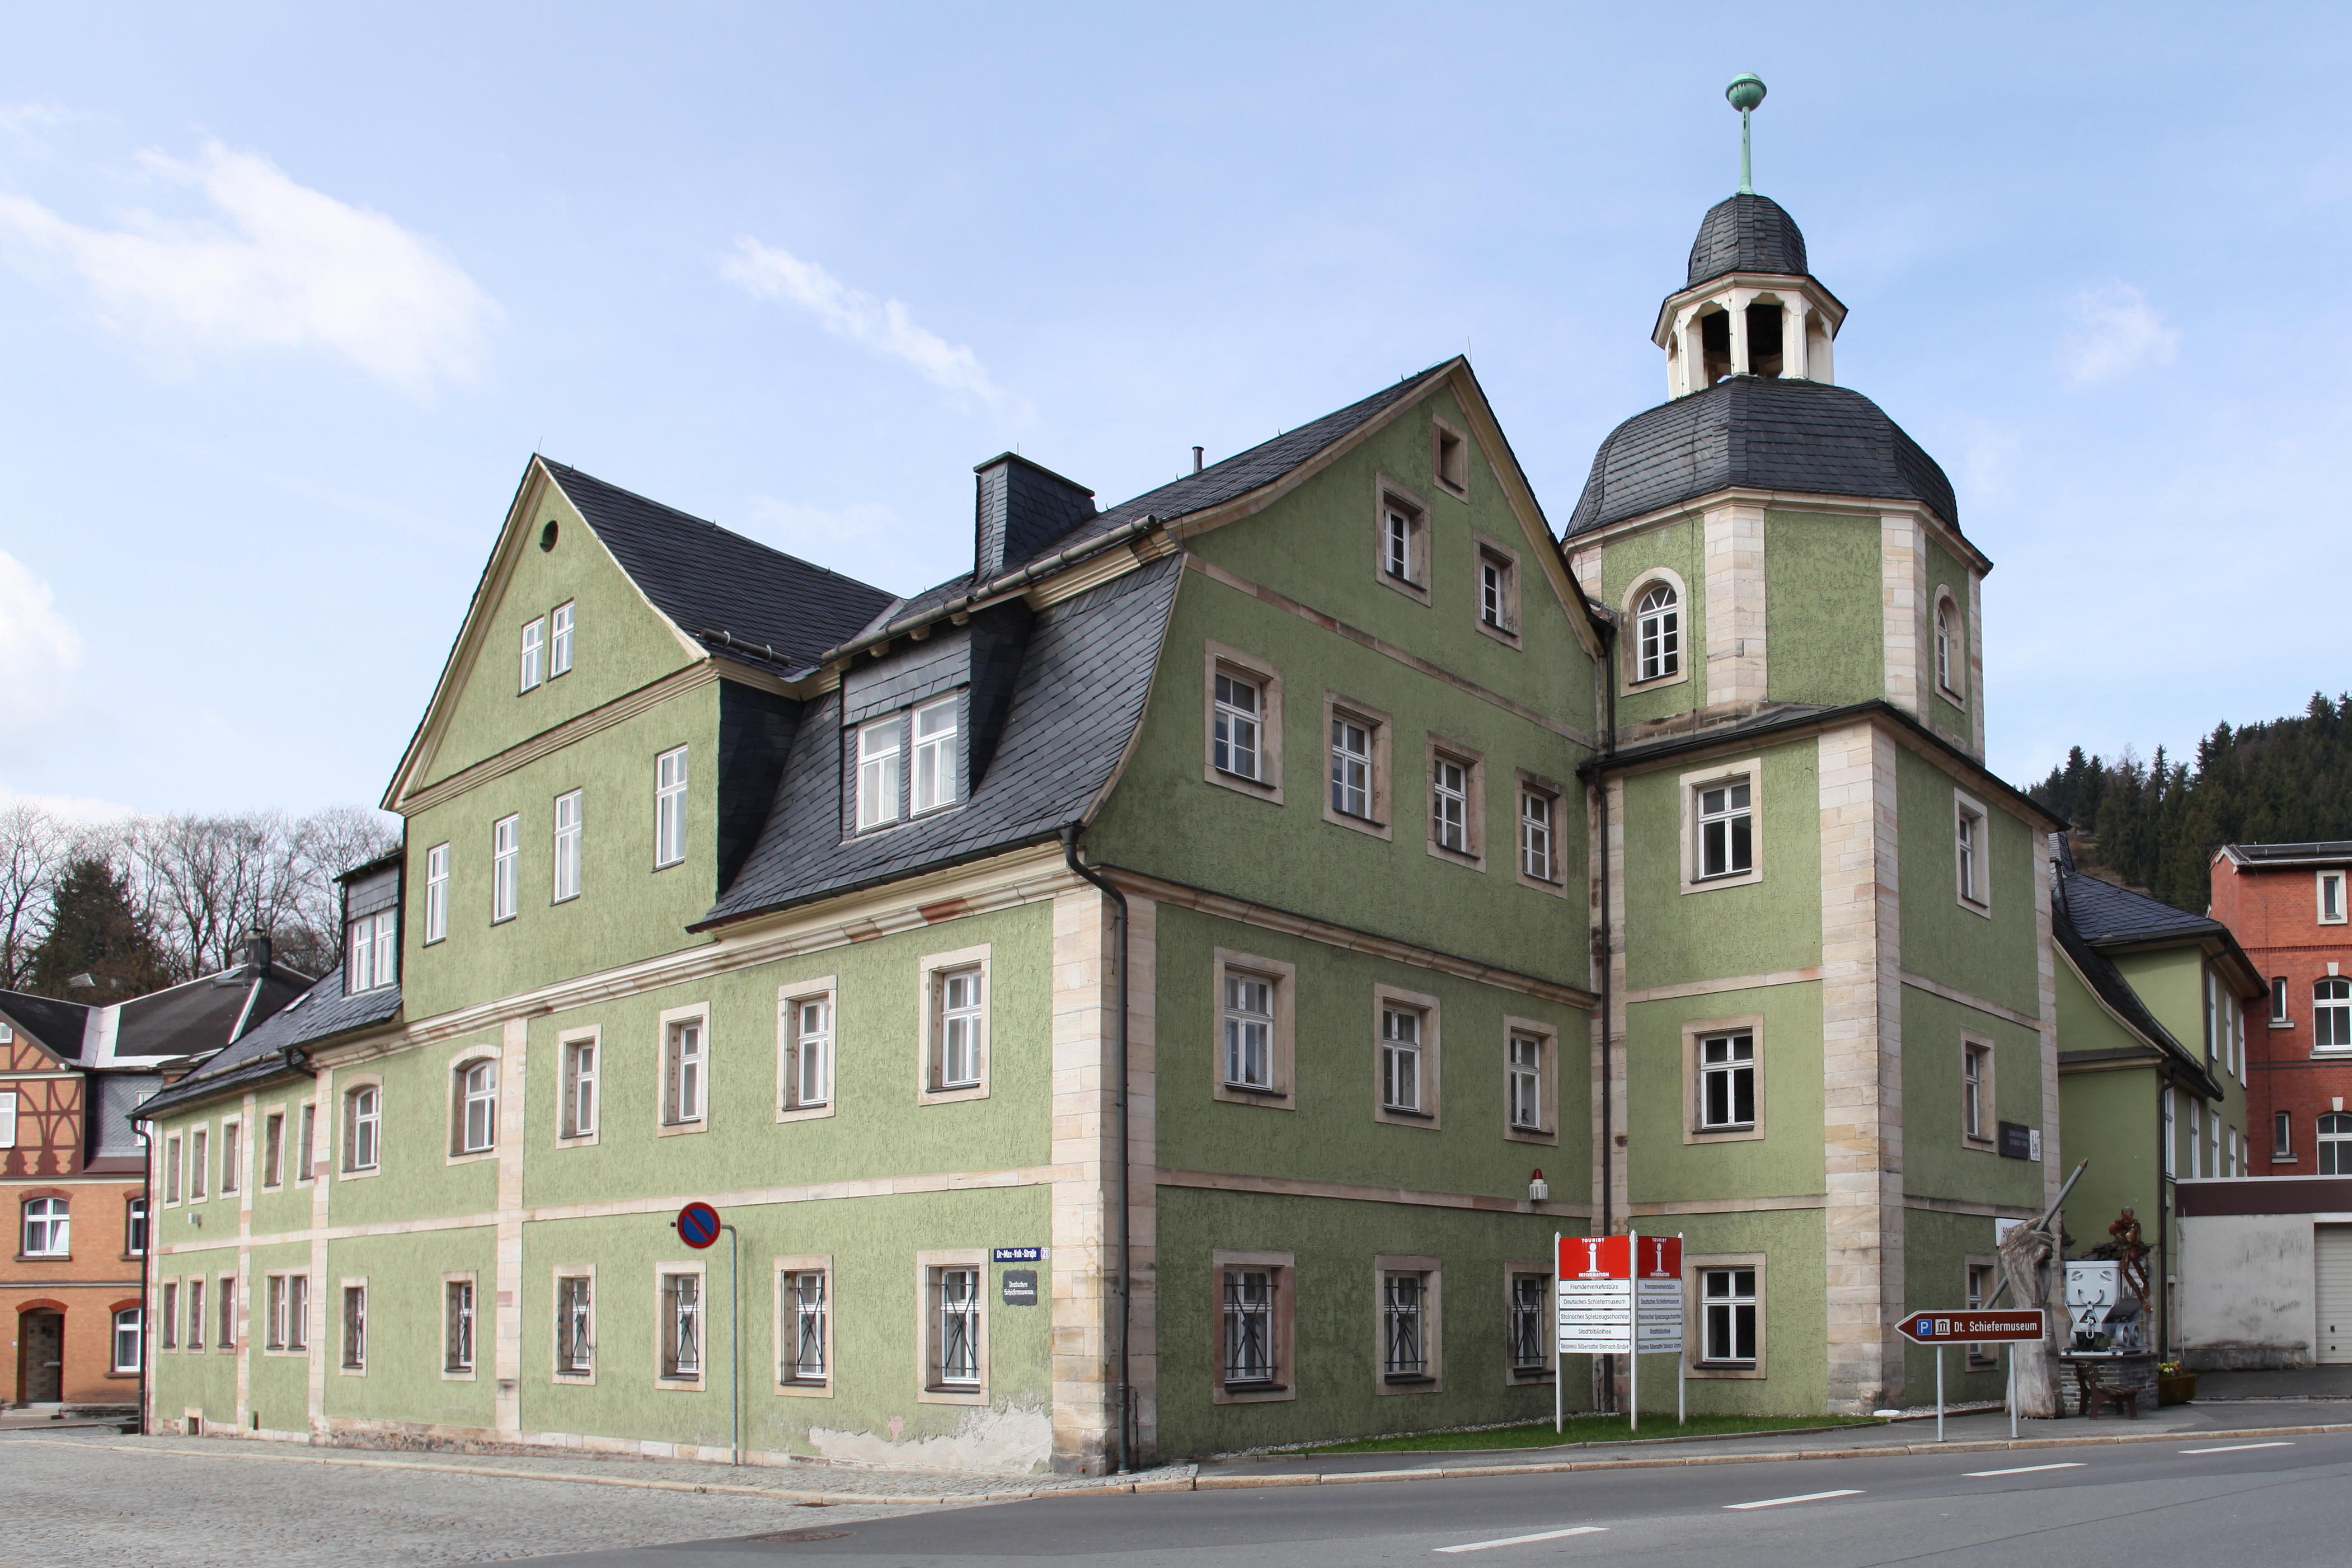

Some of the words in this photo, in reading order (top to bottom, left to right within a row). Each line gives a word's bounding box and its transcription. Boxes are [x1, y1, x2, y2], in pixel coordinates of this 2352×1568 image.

[1043, 1249, 1048, 1257] 21
[1921, 1322, 1928, 1333] P
[1954, 1321, 1965, 1332] Dt.
[1969, 1320, 2038, 1332] Schiefermuseum
